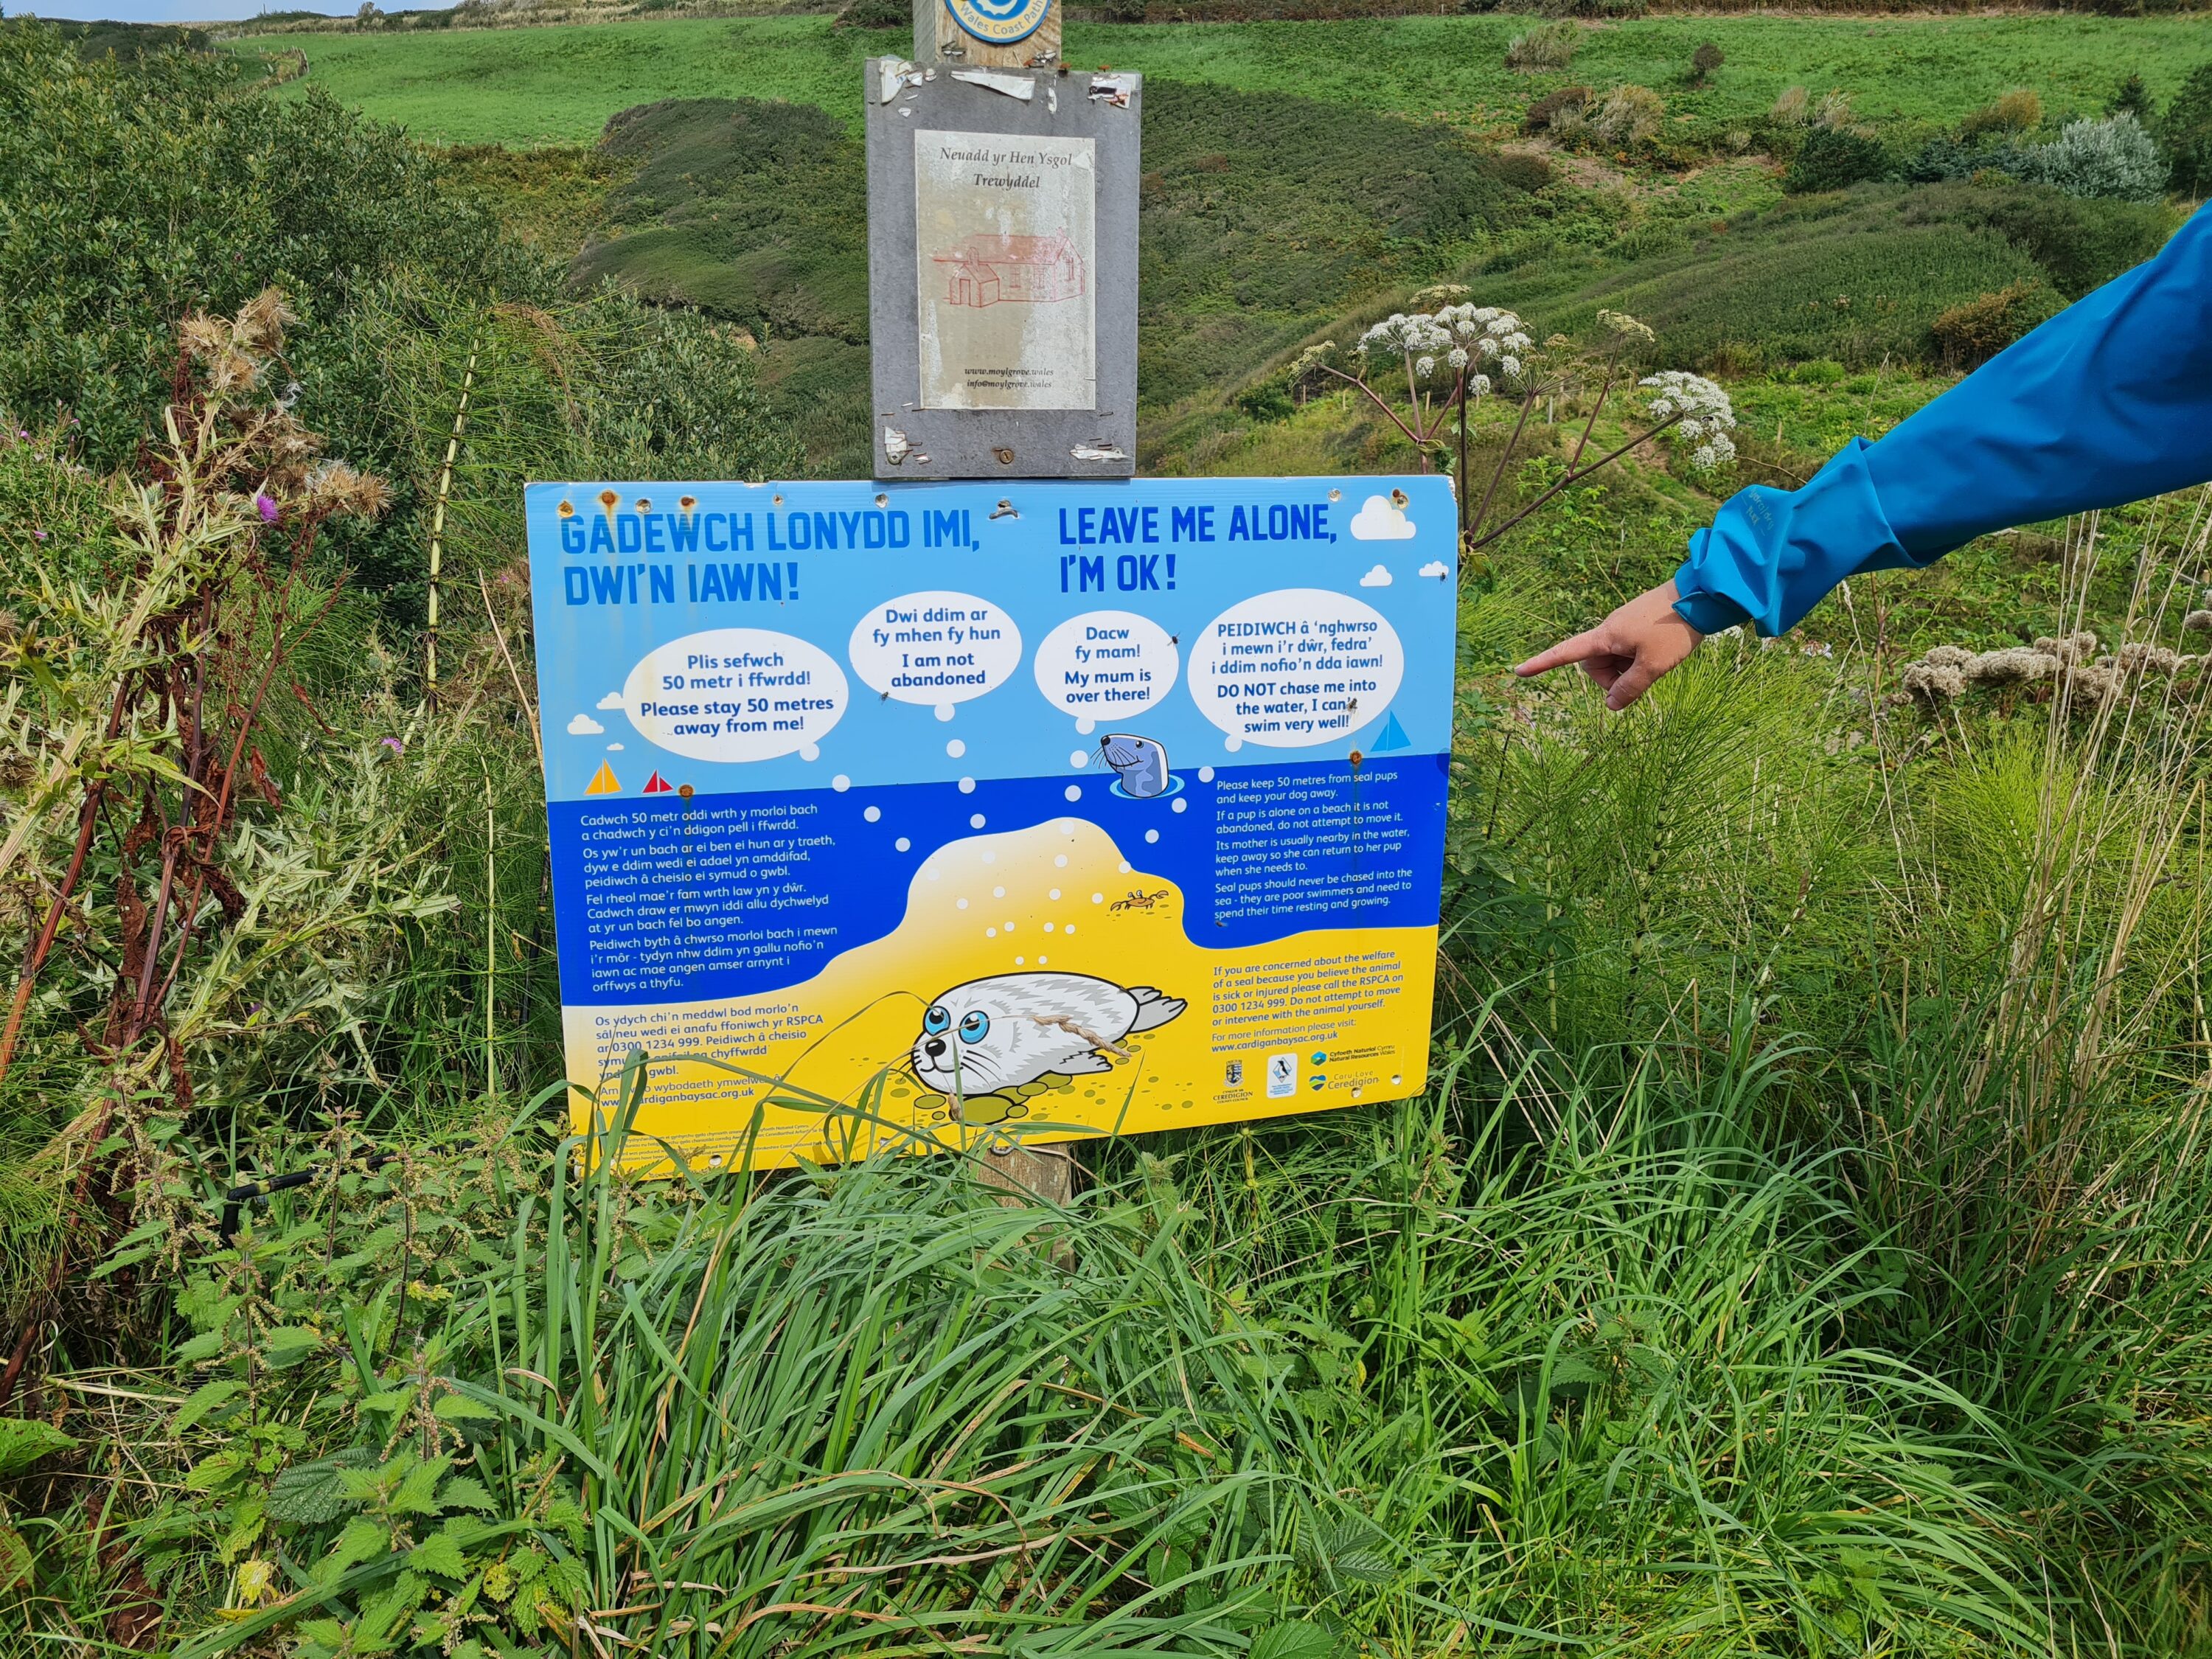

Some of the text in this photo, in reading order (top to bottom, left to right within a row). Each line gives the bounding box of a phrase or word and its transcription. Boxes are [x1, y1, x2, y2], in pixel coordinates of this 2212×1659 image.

[961, 0, 1043, 35] Wales Coast Path
[939, 147, 1072, 169] Neuadd yr Hen Ysgol
[973, 173, 1040, 191] Trewyddel
[964, 366, 1054, 378] www.moylgrove.wales
[967, 379, 1051, 390] info@moylgrove.wales
[561, 509, 979, 554] GADEWCH LONYDD IMI,
[1059, 504, 1337, 544] LEAVE ME ALONE,
[1060, 554, 1175, 593] I'M OK!
[564, 562, 799, 605] DWI'N IAWN!
[886, 608, 987, 623] Dwi ddim ar
[873, 626, 1001, 647] fy mhen fy hun
[1086, 627, 1130, 640] Dacw
[1218, 619, 1377, 637] PEIDIWCH â 'nghwrso
[1075, 644, 1140, 663] fy mam!
[1223, 637, 1371, 655] i mewn i'r dŵr, fedra'
[687, 652, 784, 669] Plis sefwch
[902, 653, 974, 667] I am not
[1212, 654, 1382, 674] i ddim nofio'n dda iawn!
[663, 671, 810, 690] 50 metr i ffwrdd!
[891, 670, 985, 687] abandoned
[1065, 668, 1152, 687] My mum is
[1066, 686, 1150, 703] over there!
[1217, 679, 1377, 698] DO NOT chase me into
[641, 698, 834, 717] Please stay 50 metres
[1236, 697, 1356, 715] the water, I can'
[674, 716, 804, 737] away from me!
[1245, 714, 1349, 733] swim very well!
[1217, 771, 1398, 790] Please keep 50 metres from seal pups
[580, 804, 818, 826] Cadwch 50 metr oddi wrth y morloi bach
[593, 827, 645, 840] chadwch
[649, 830, 655, 840] y
[659, 826, 681, 836] ci'n
[684, 824, 725, 836] ddigon
[728, 821, 748, 835] pell
[751, 821, 755, 832] i
[758, 819, 799, 831] ffwrdd.
[1215, 868, 1413, 893] Seal pups should never be chased into the
[1214, 897, 1391, 921] spend their time resting and growing.
[1213, 992, 1220, 1001] is
[1223, 990, 1240, 1000] sick
[1256, 985, 1289, 998] injured
[1292, 984, 1321, 995] please
[1324, 979, 1339, 990] call
[1342, 979, 1357, 987] the
[1360, 975, 1390, 985] RSPCA
[595, 1003, 799, 1026] Os ydych chi'n meddwl bod morlo'n
[612, 1041, 642, 1052] 0300
[647, 1039, 674, 1050] 1234
[678, 1037, 702, 1047] 999.
[706, 1033, 754, 1045] Peidiwch
[759, 1032, 765, 1041] â
[768, 1030, 807, 1040] cheisio
[1211, 1030, 1338, 1052] www.cardiganbaysac.org.uk
[1329, 1049, 1352, 1057] Cyfoeth
[1354, 1046, 1376, 1054] Naturiol
[1328, 1077, 1379, 1090] Ceredigion
[1213, 1091, 1253, 1100] CEREDIGION
